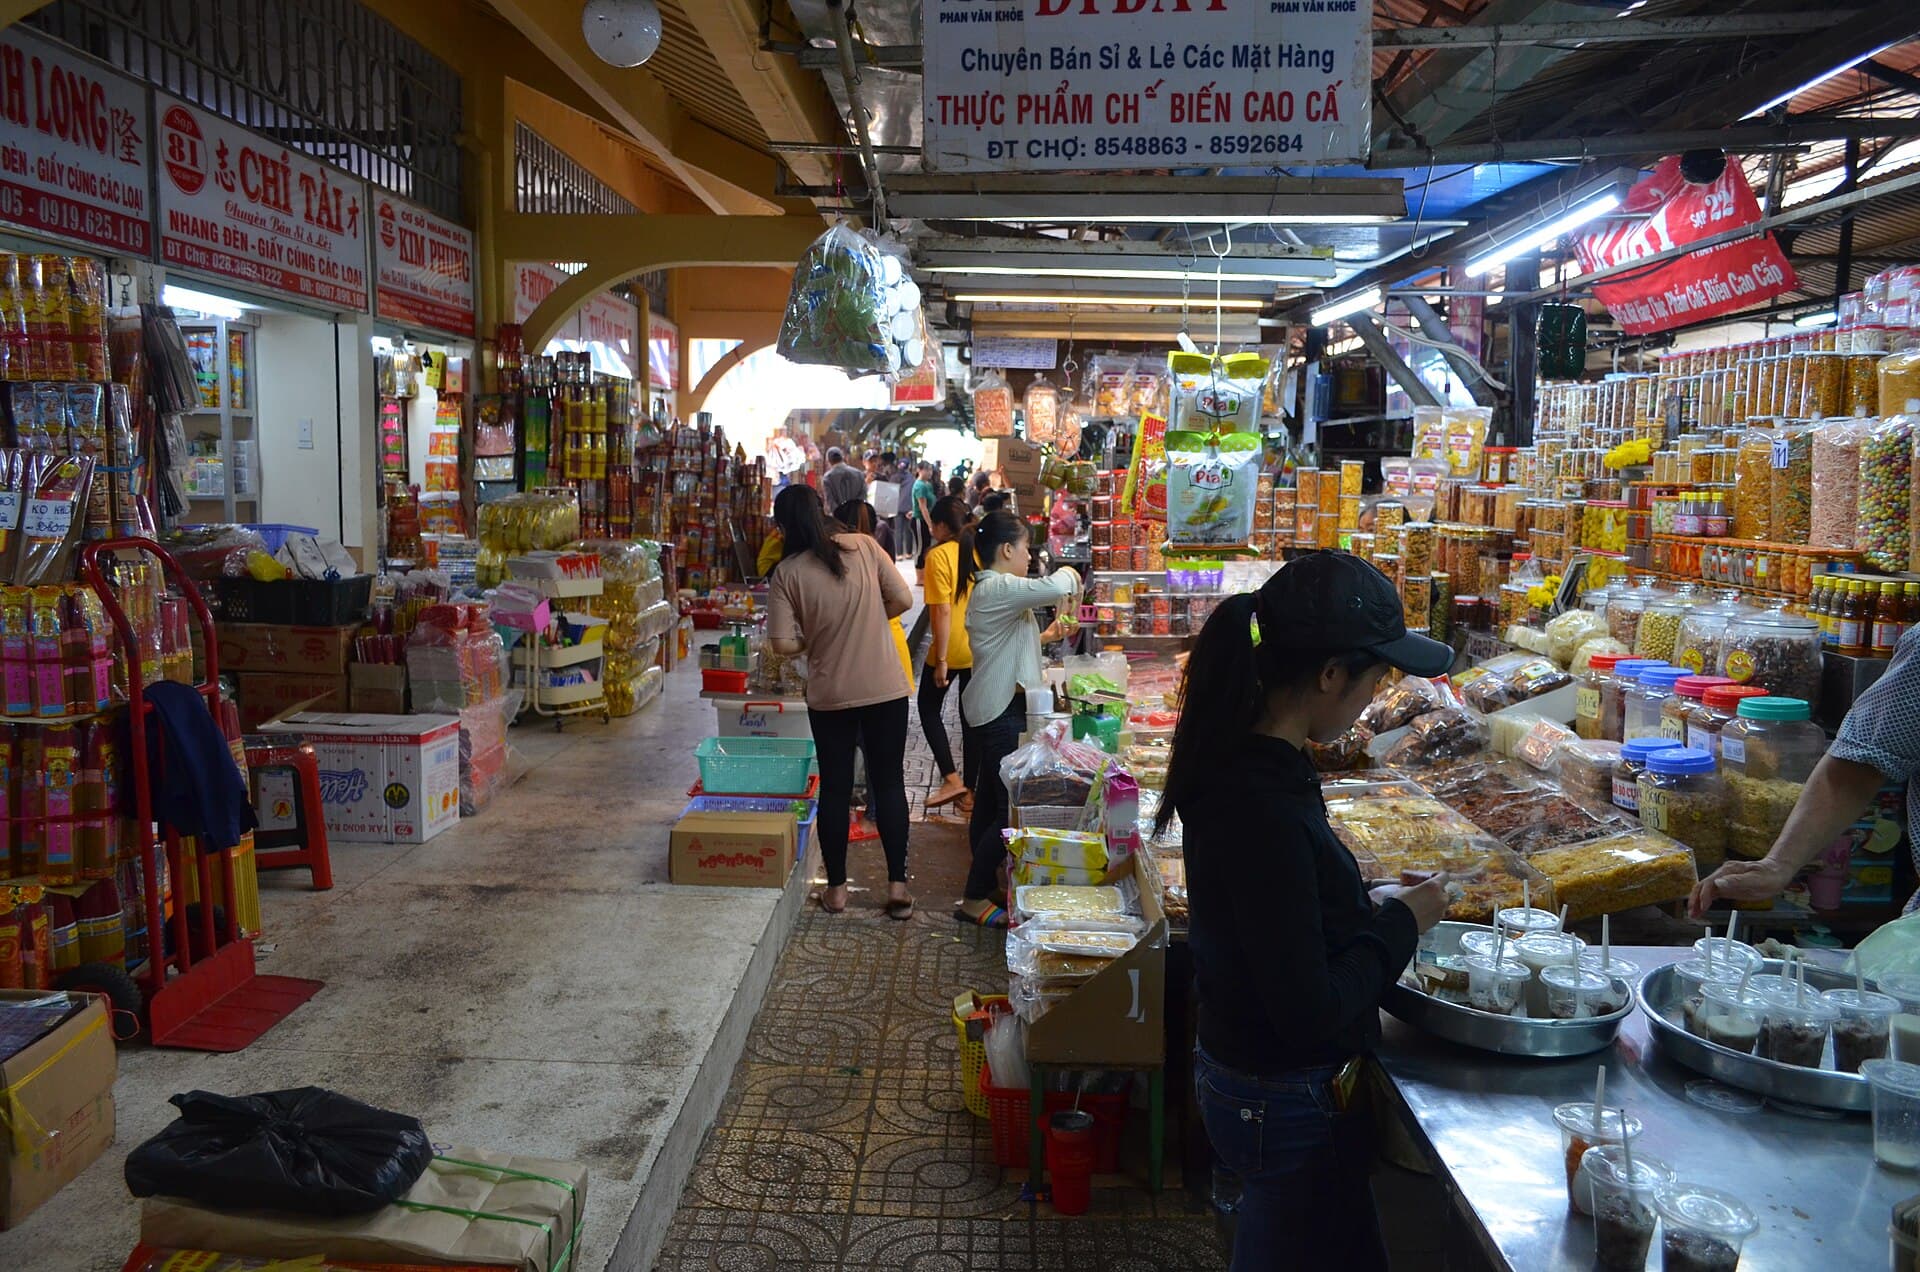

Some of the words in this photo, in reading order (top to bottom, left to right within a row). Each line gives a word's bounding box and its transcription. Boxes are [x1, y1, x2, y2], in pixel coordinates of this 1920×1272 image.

[940, 12, 968, 23] PHAN
[971, 9, 992, 22] VĂN
[995, 7, 1024, 22] KHỎE
[1271, 2, 1300, 13] PHAN
[961, 48, 1042, 77] Chuyên
[1050, 46, 1091, 70] Bán
[1099, 43, 1120, 70] Sỉ
[1127, 46, 1141, 69] &
[1150, 43, 1175, 69] Lẻ
[1183, 44, 1224, 69] Các
[1232, 44, 1271, 73] Mặt
[1278, 43, 1334, 74] Hàng
[31, 55, 108, 154] LONG
[937, 90, 1005, 131] THỰC
[1017, 80, 1093, 125] PHẨM
[1170, 81, 1231, 123] BIẾN
[1244, 91, 1294, 122] CAO
[168, 132, 200, 169] 81
[987, 140, 1019, 159] ĐT
[1026, 136, 1086, 161] CHỢ:
[1094, 136, 1187, 156] 8548863
[1210, 134, 1303, 154] 8592684
[2, 141, 28, 176] ĐÈN
[37, 152, 65, 187] GIẤY
[67, 162, 98, 198] CÚNG
[100, 172, 120, 204] CÁC
[122, 183, 144, 216] LOẠI
[299, 167, 345, 236] TÀI
[40, 197, 143, 249] 0919.625.119
[1705, 189, 1735, 221] 22
[169, 208, 219, 243] NHANG
[223, 225, 249, 252] ĐÈN
[258, 235, 284, 262] GIẤY
[287, 245, 316, 273] CÚNG
[318, 255, 339, 279] CÁC
[341, 264, 363, 290] LOẠI
[399, 226, 425, 269] KIM
[429, 237, 470, 286] PHỤNG
[1702, 273, 1733, 304] Biến
[1728, 270, 1756, 296] Cao
[1752, 256, 1784, 288] Cấp
